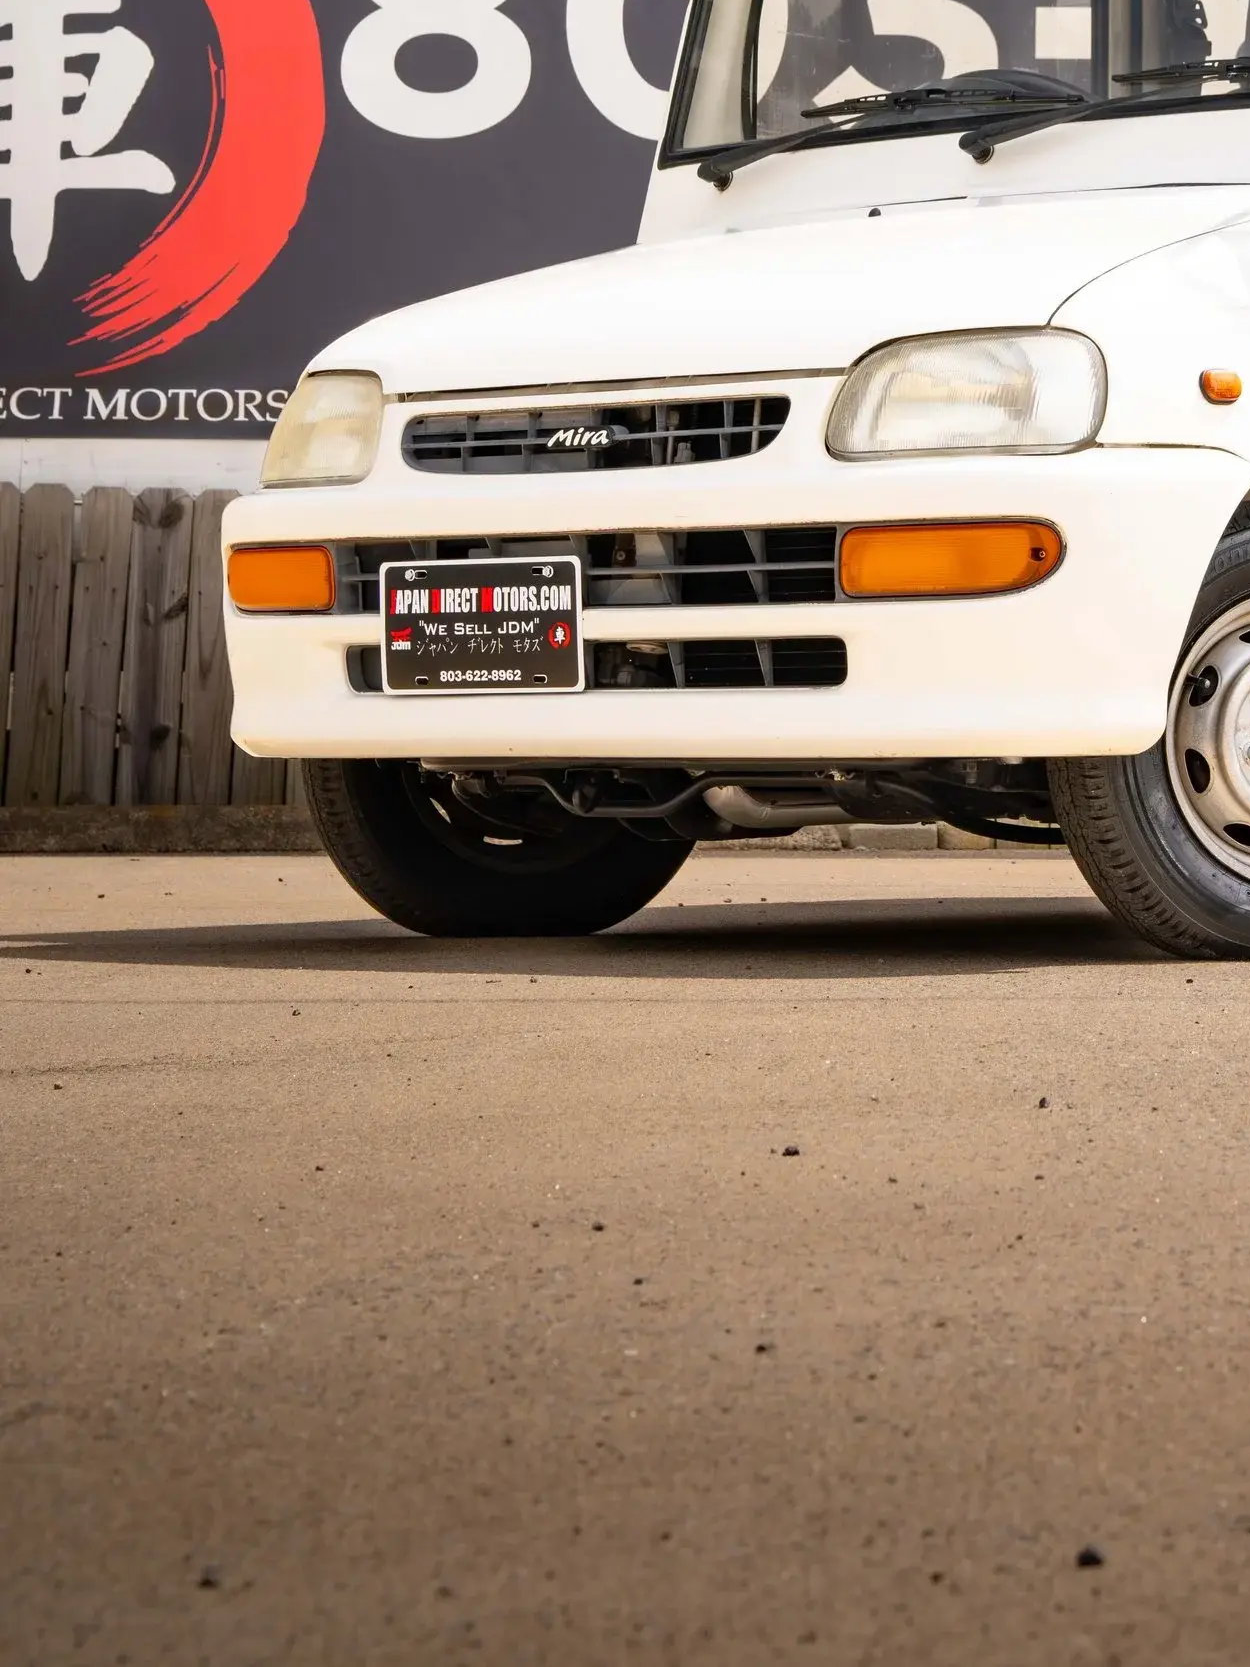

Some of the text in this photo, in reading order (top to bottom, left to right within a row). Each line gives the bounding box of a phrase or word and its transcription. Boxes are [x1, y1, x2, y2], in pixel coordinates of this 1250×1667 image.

[0, 386, 289, 422] CT MOTORS
[547, 427, 609, 447] Mira
[481, 585, 571, 613] MOTORS.COM
[440, 669, 522, 683] 803-622-8962
